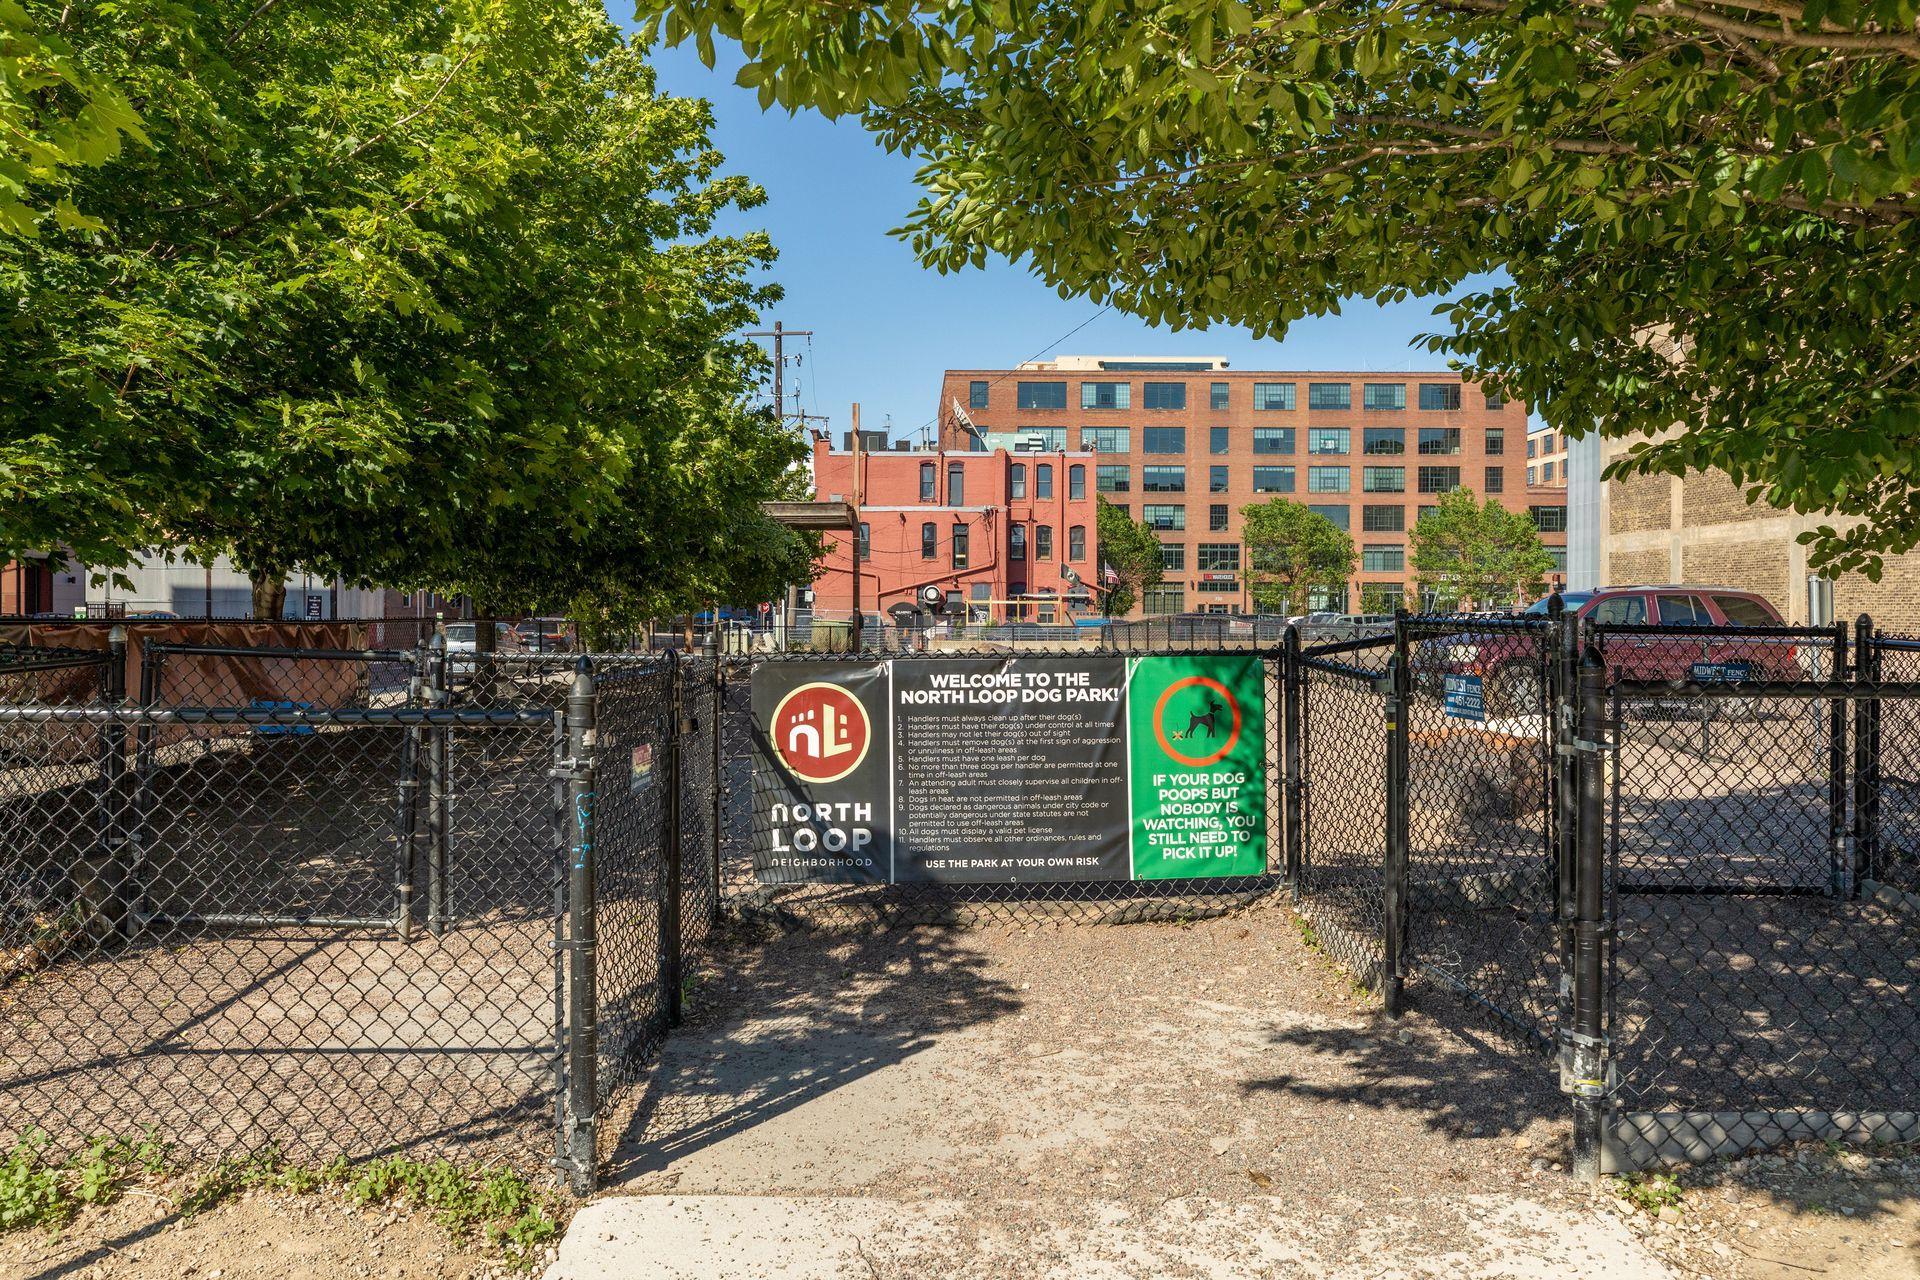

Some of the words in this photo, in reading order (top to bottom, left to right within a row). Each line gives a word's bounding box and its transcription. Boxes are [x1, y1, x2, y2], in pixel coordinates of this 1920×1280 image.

[930, 673, 1021, 688] WELCOME
[1025, 673, 1050, 687] TO
[1055, 673, 1089, 686] THE
[901, 690, 964, 704] NORTH
[969, 689, 1018, 703] LOOP
[1022, 689, 1062, 702] DOG
[1066, 688, 1118, 701] PARK!
[961, 714, 986, 722] always
[1057, 713, 1082, 721] dog(s)
[999, 722, 1023, 730] dog(s)
[1003, 730, 1027, 738] dog(s)
[1053, 729, 1070, 737] sight
[990, 738, 1014, 746] dog(s)
[981, 762, 998, 770] dogs
[1058, 761, 1092, 769] permitted
[921, 779, 955, 787] attending
[997, 778, 1023, 786] closely
[1153, 774, 1166, 786] IF
[1170, 774, 1210, 785] YOUR
[1213, 773, 1245, 784] DOG
[909, 795, 927, 803] Dogs
[984, 794, 1019, 802] permitted
[1159, 789, 1208, 801] POOPS
[1212, 787, 1239, 799] BUT
[909, 803, 928, 811] Dogs
[972, 802, 1011, 810] dangerous
[1160, 803, 1222, 815] NOBODY
[1226, 802, 1238, 813] IS
[909, 811, 947, 819] potentially
[949, 811, 987, 819] dangerous
[1143, 818, 1224, 830] WATCHING,
[1227, 816, 1255, 827] YOU
[772, 828, 872, 852] LOOP
[1148, 833, 1186, 845] STILL
[1190, 831, 1228, 843] NEED
[1231, 831, 1250, 842] TO
[910, 844, 950, 852] regulations
[1163, 847, 1196, 859] PICK
[1199, 846, 1212, 858] IT
[1215, 845, 1237, 857] UP!
[926, 860, 945, 868] USE
[1048, 858, 1073, 866] OWN
[1076, 857, 1099, 866] RISK
